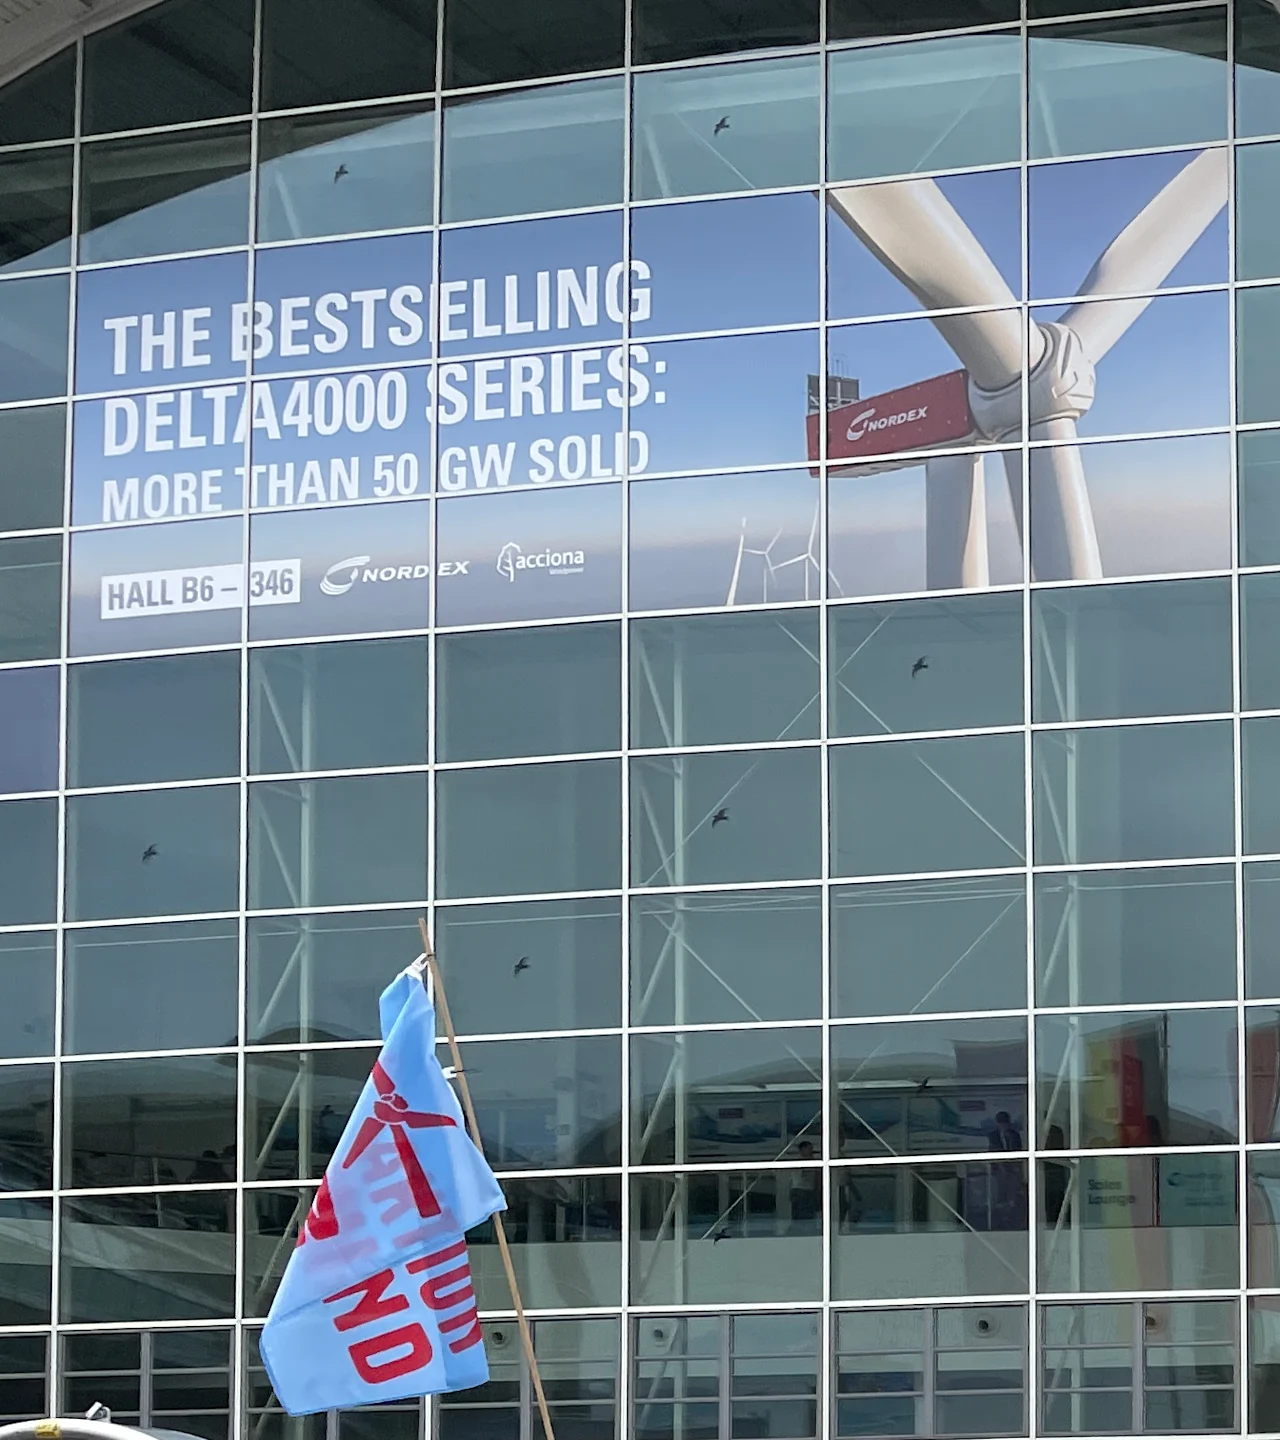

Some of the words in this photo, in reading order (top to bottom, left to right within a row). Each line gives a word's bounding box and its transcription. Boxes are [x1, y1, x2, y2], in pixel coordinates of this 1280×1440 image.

[103, 306, 211, 376] THE
[231, 259, 653, 365] BESTSELLING
[103, 370, 408, 458] DELTA4000
[428, 342, 668, 426] SERIES:
[867, 406, 929, 432] NORDEX
[102, 467, 223, 523] MORE
[234, 454, 361, 509] THAN
[373, 452, 418, 499] 50
[440, 441, 517, 494] GW
[529, 429, 650, 485] SOLD
[362, 559, 470, 583] NORDEX
[515, 548, 585, 570] acciona
[107, 578, 174, 612] HALL
[181, 575, 215, 605] B6
[250, 567, 294, 598] 346
